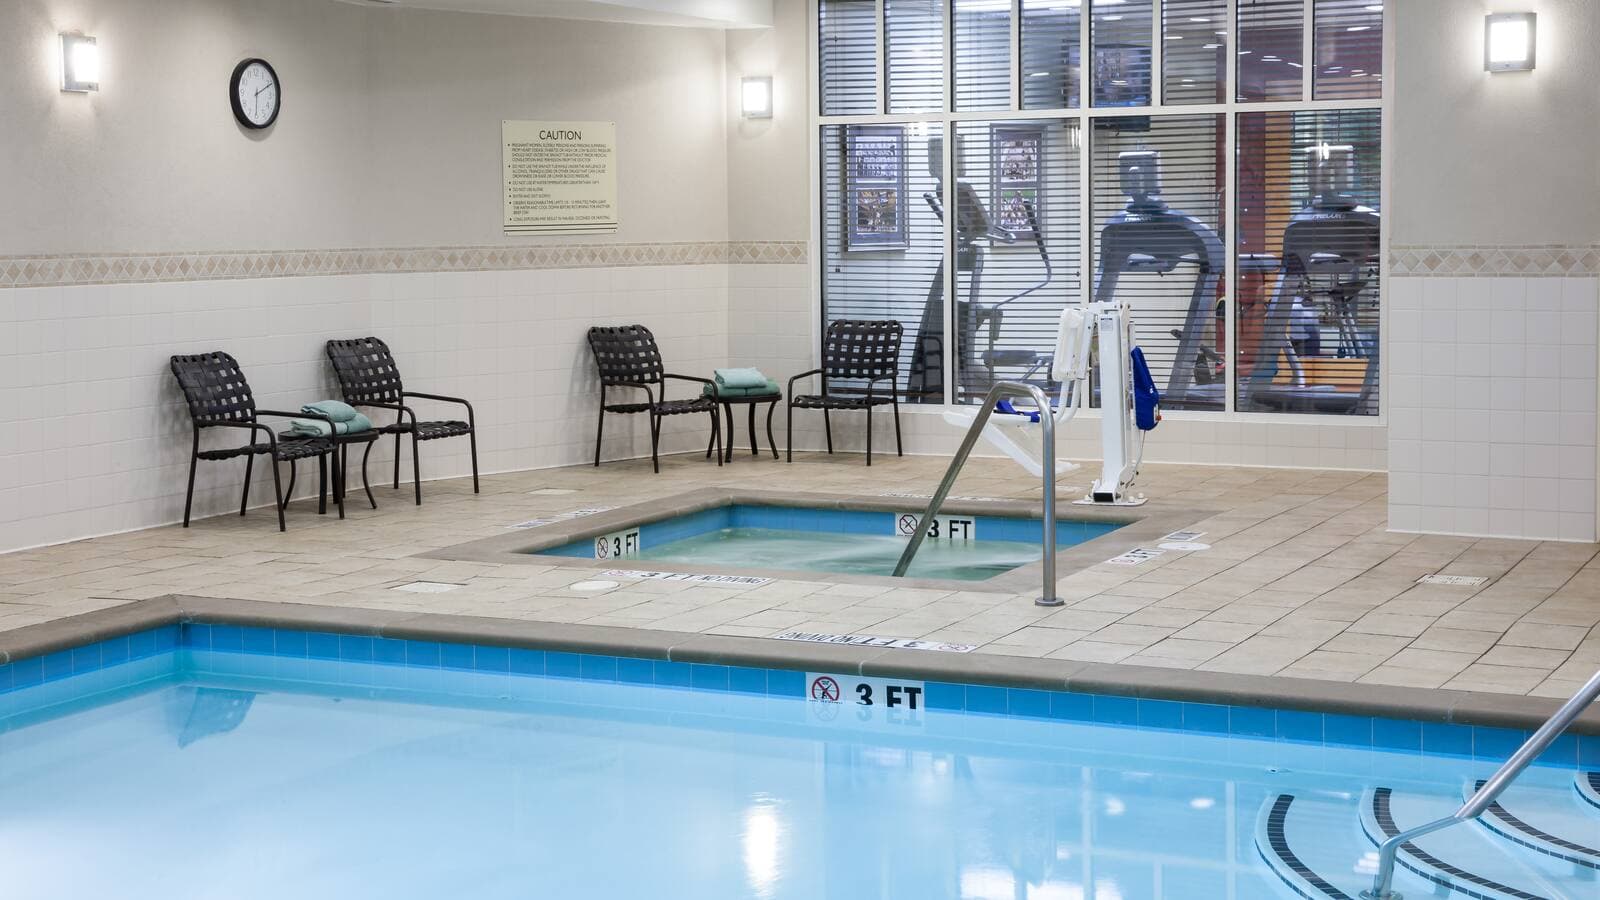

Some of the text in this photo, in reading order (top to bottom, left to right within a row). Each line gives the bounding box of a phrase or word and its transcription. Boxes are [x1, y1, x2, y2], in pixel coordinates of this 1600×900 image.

[539, 130, 582, 140] CAUTION
[927, 519, 972, 539] 3 FT
[613, 532, 638, 557] 3 FT
[856, 683, 922, 710] 3 FT
